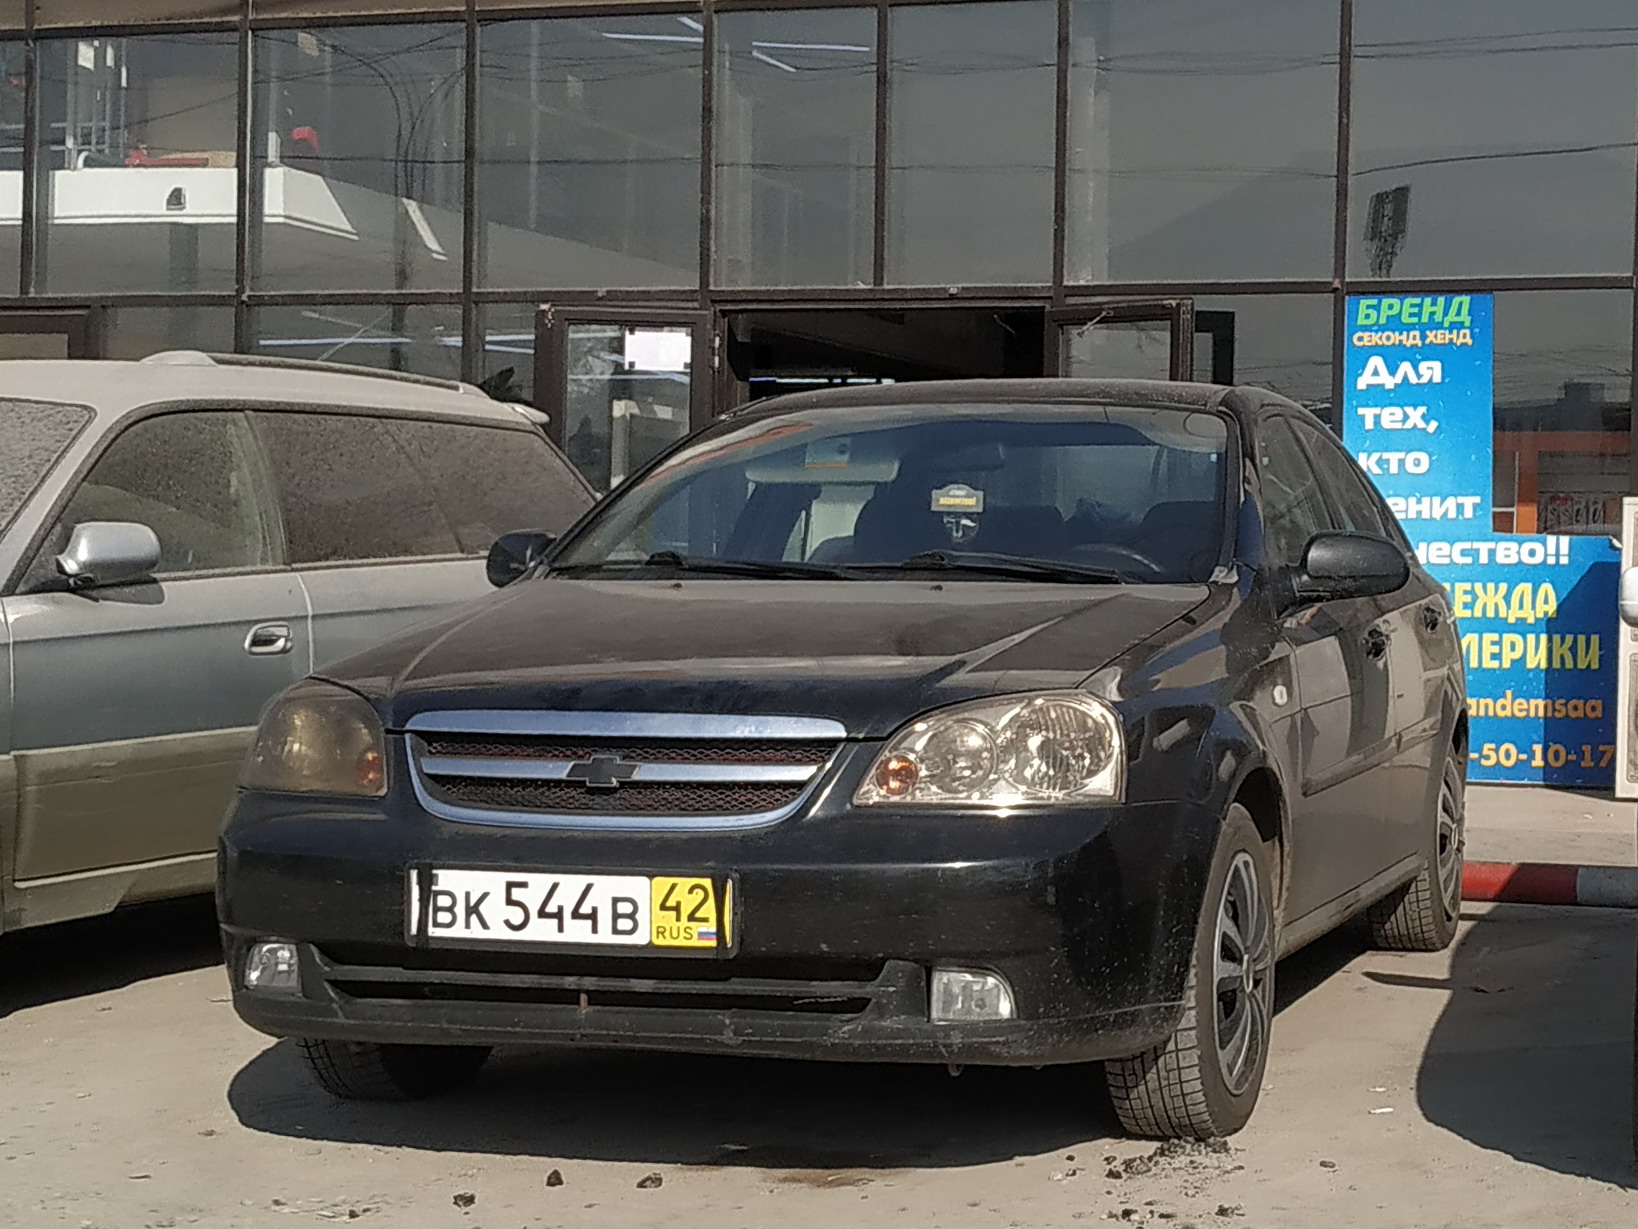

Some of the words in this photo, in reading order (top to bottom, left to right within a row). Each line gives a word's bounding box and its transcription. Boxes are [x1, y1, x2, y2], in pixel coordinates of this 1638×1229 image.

[1357, 295, 1472, 328] БРЕНД
[1353, 330, 1422, 347] СЕКОНД
[1425, 329, 1473, 346] ХЕНД
[1357, 355, 1442, 390] Для
[1357, 406, 1438, 433] тех,
[1358, 451, 1430, 475] кто
[1442, 582, 1557, 624] ЕЖДА
[659, 882, 711, 923] 42
[656, 925, 694, 941] RUS
